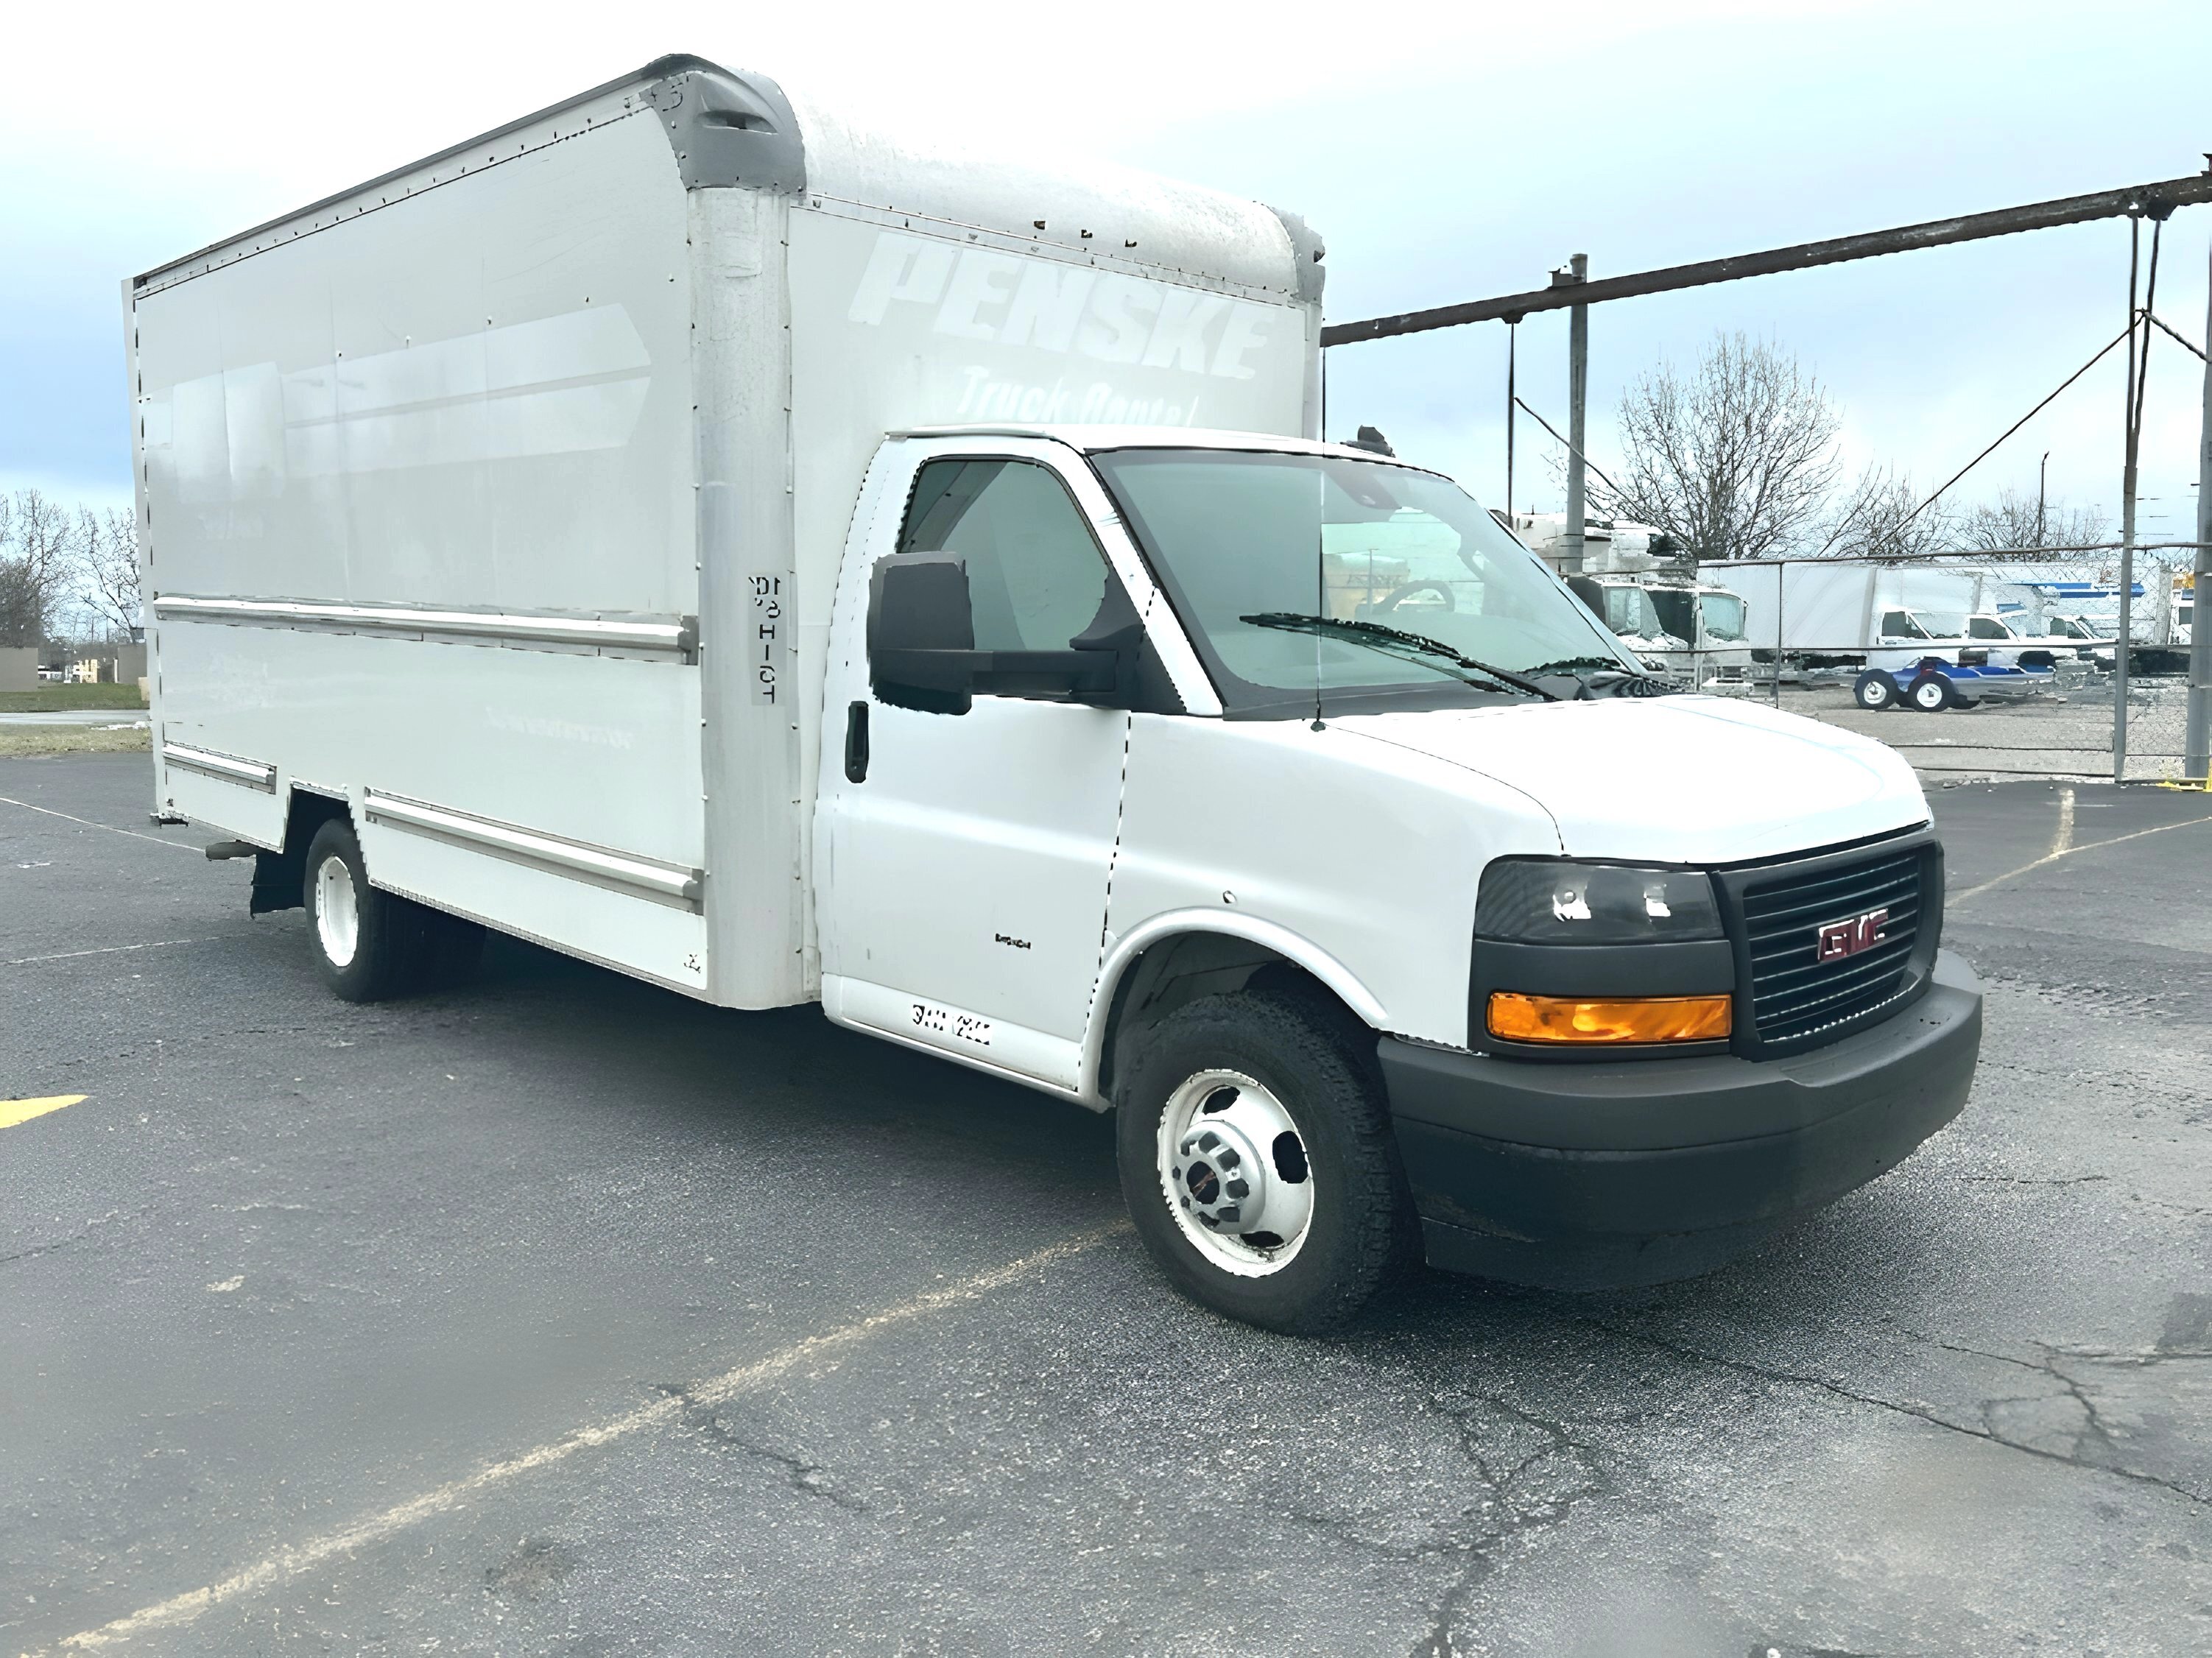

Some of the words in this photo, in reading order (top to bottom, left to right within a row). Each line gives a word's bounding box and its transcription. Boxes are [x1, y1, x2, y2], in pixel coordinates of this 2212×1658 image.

[848, 231, 1275, 380] PENSKE
[957, 365, 1071, 423] Truck
[1818, 909, 1889, 963] GMC
